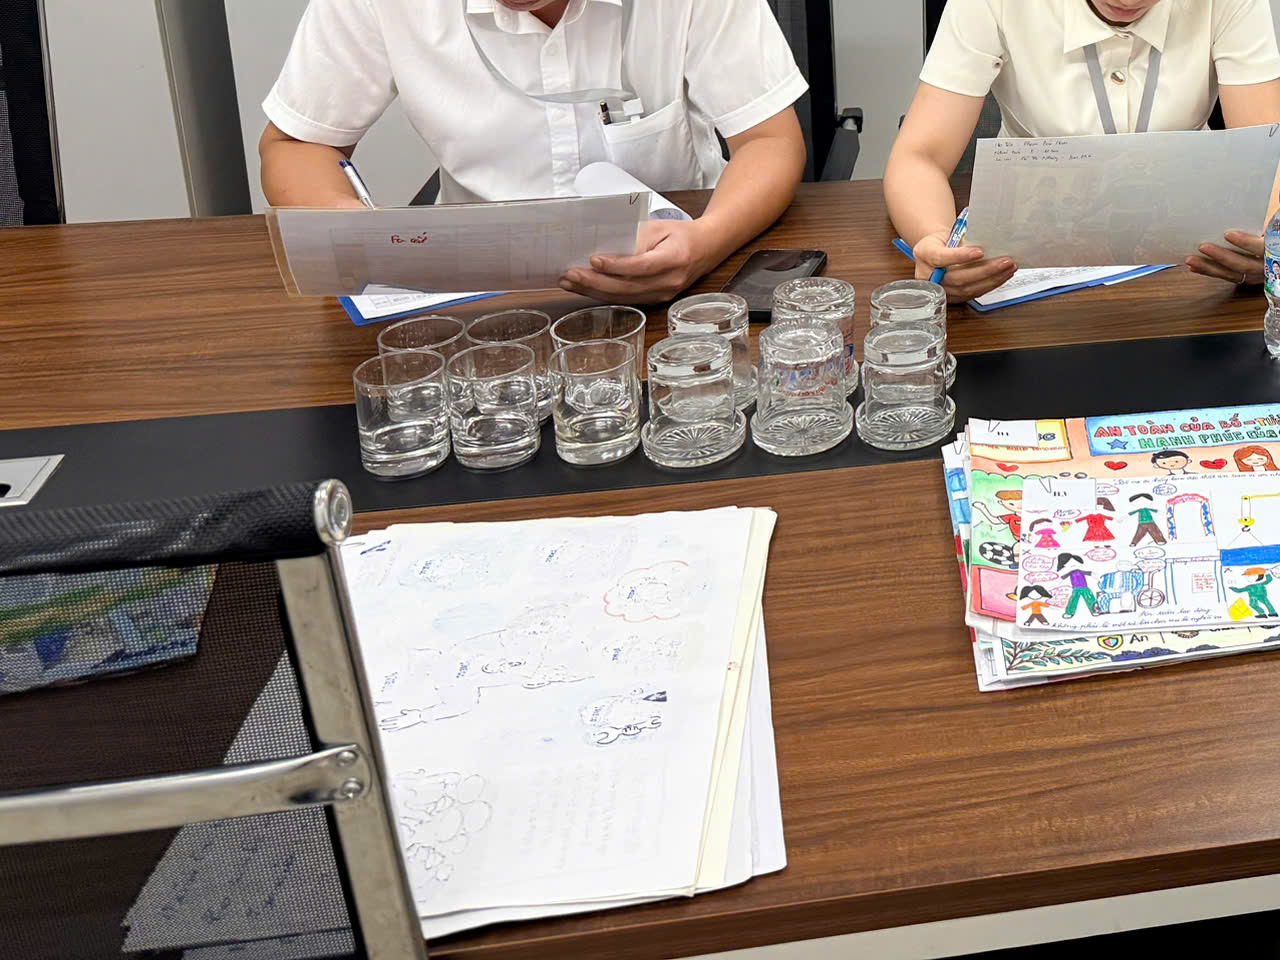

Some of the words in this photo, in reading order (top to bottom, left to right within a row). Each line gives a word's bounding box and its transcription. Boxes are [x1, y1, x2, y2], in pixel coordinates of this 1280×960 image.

[1094, 425, 1122, 438] AN
[1124, 420, 1176, 436] TOÀN
[1180, 416, 1215, 432] CỦA
[1129, 634, 1149, 645] An
